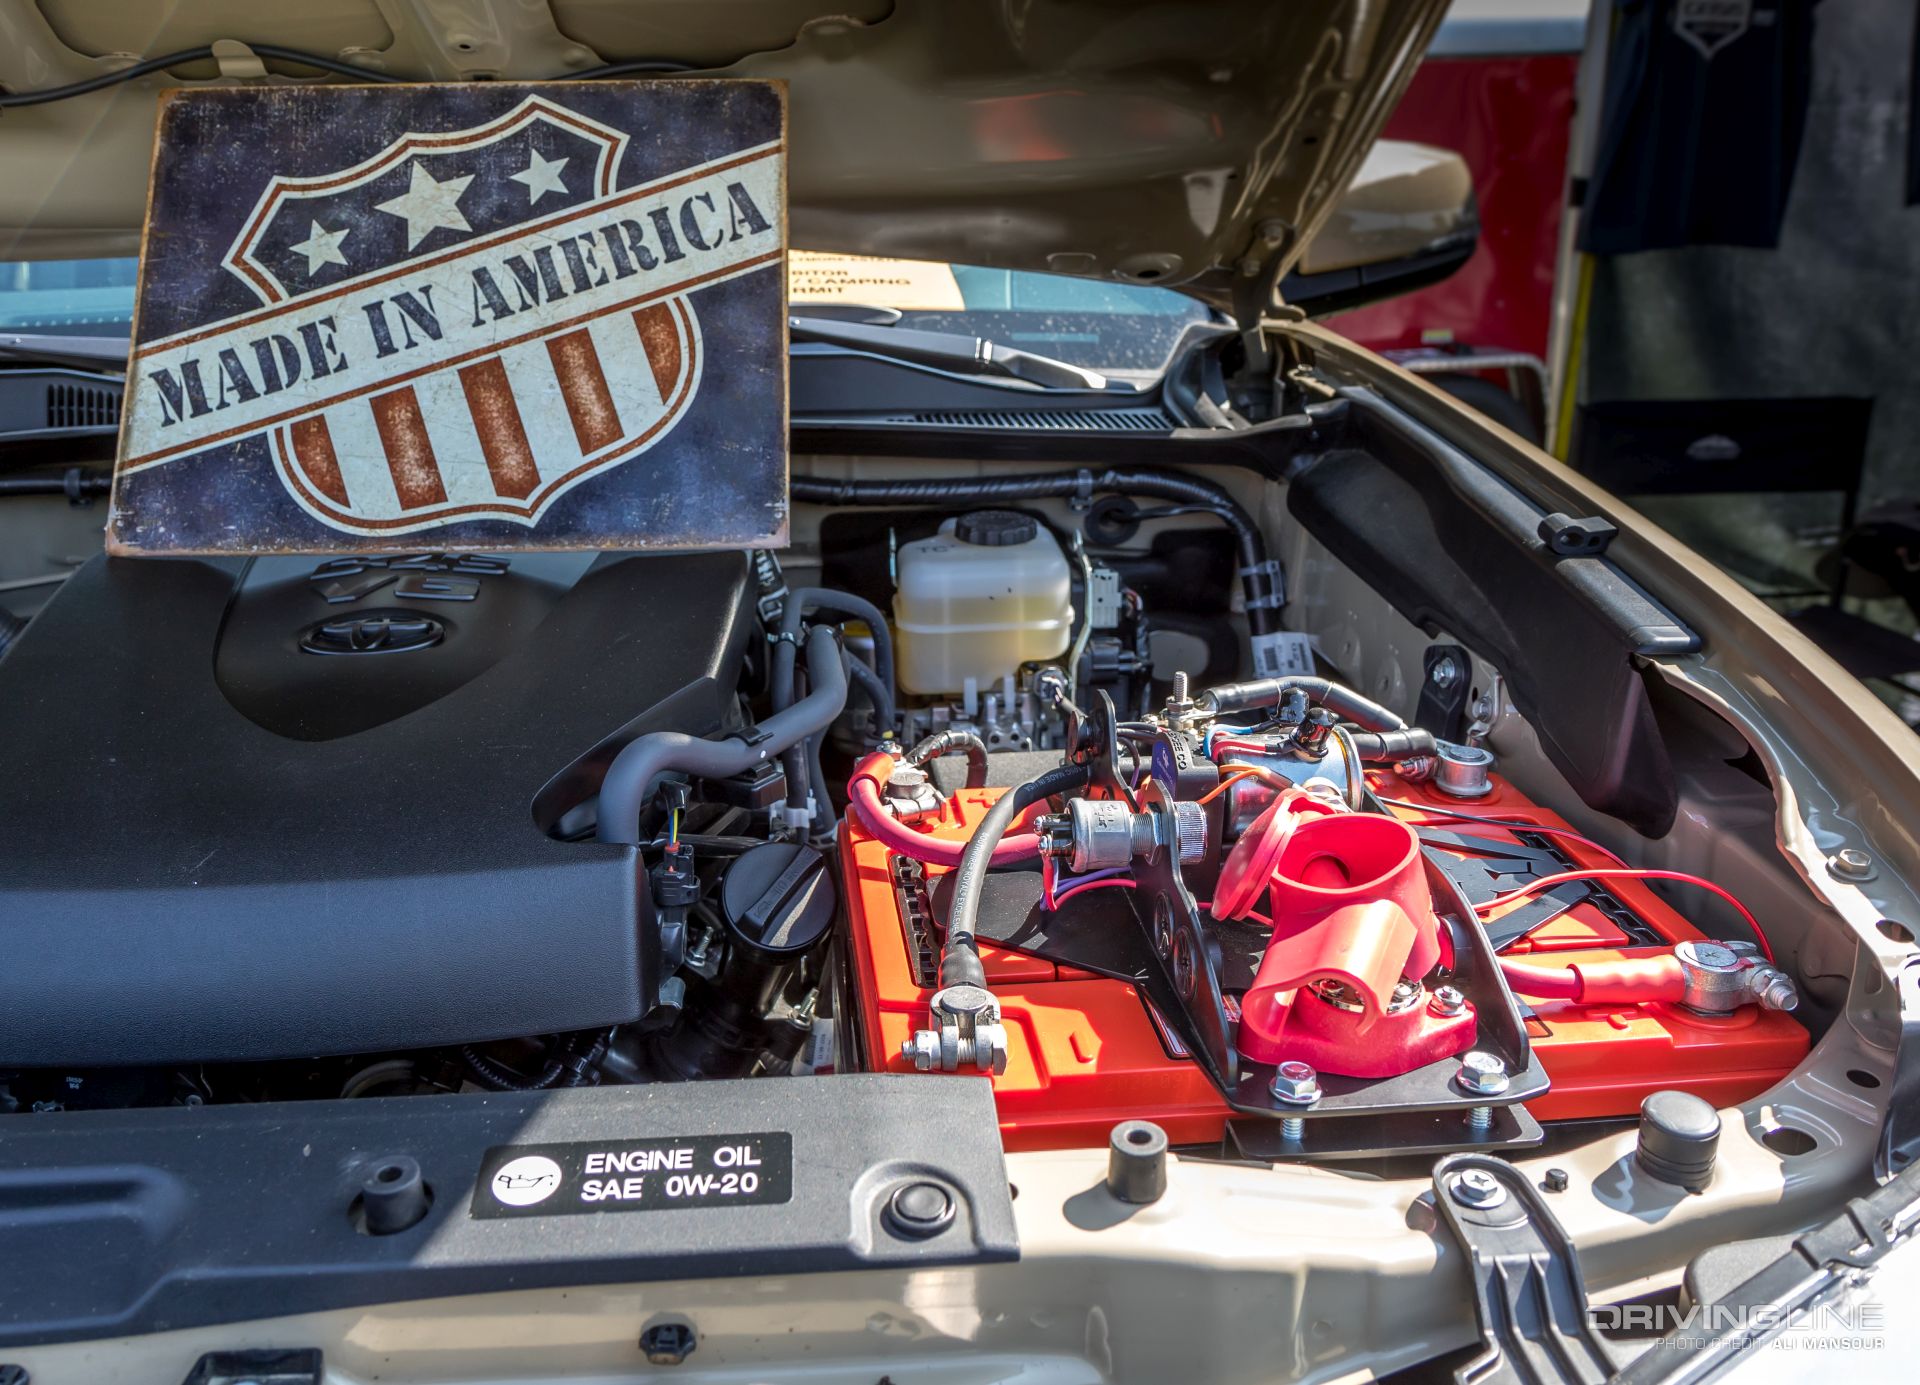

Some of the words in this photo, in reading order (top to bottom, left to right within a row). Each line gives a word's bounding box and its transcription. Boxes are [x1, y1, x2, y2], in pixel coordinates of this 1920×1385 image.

[792, 286, 844, 294] RMIT
[807, 277, 912, 286] CAMPING
[148, 316, 349, 428] MADE
[361, 284, 444, 360] IN
[471, 181, 773, 328] AMERICA
[584, 1148, 695, 1175] ENGINE
[713, 1145, 762, 1168] OIL
[580, 1177, 645, 1202] SAE
[664, 1171, 760, 1198] 0W-20
